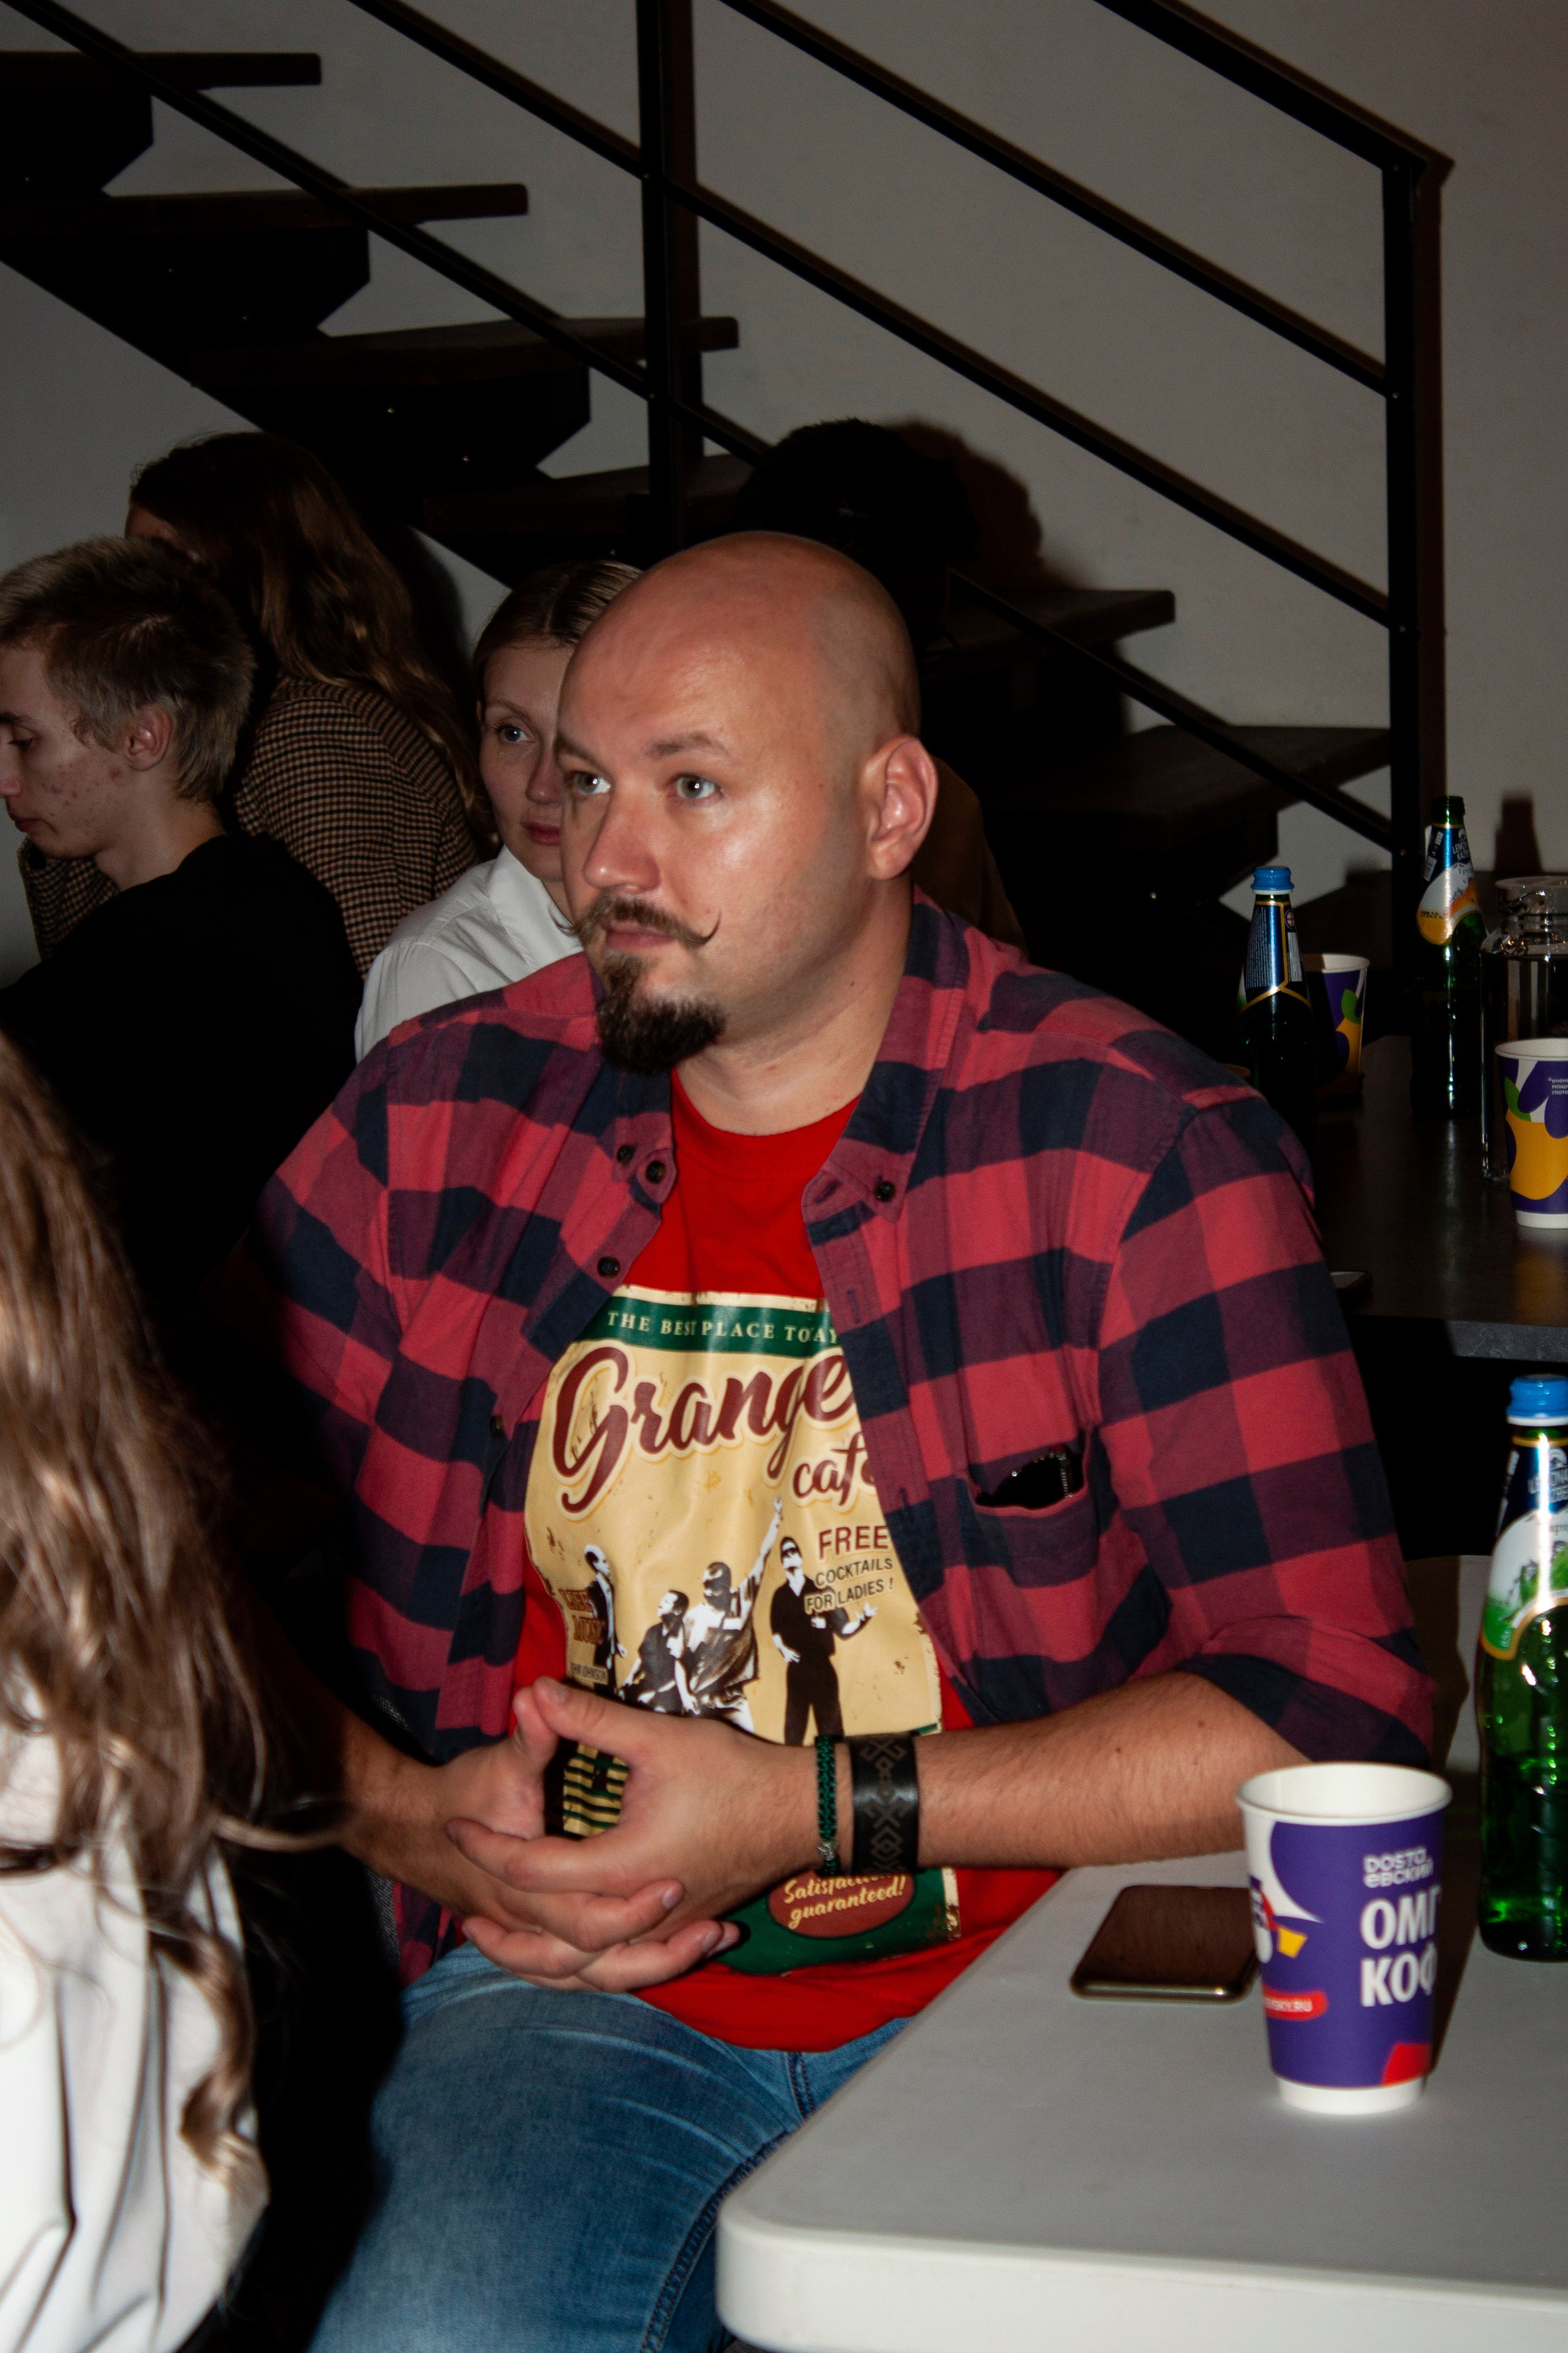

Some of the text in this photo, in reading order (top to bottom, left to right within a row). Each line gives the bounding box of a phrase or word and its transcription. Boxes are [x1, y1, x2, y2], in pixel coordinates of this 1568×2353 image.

[607, 1310, 650, 1331] THE
[701, 1320, 775, 1339] PLACE
[553, 1346, 854, 1513] Grange
[818, 1525, 889, 1560] FREE
[815, 1558, 894, 1587] COCKTAILS
[806, 1593, 834, 1611] FOR
[788, 1875, 907, 1930] guaranteed!
